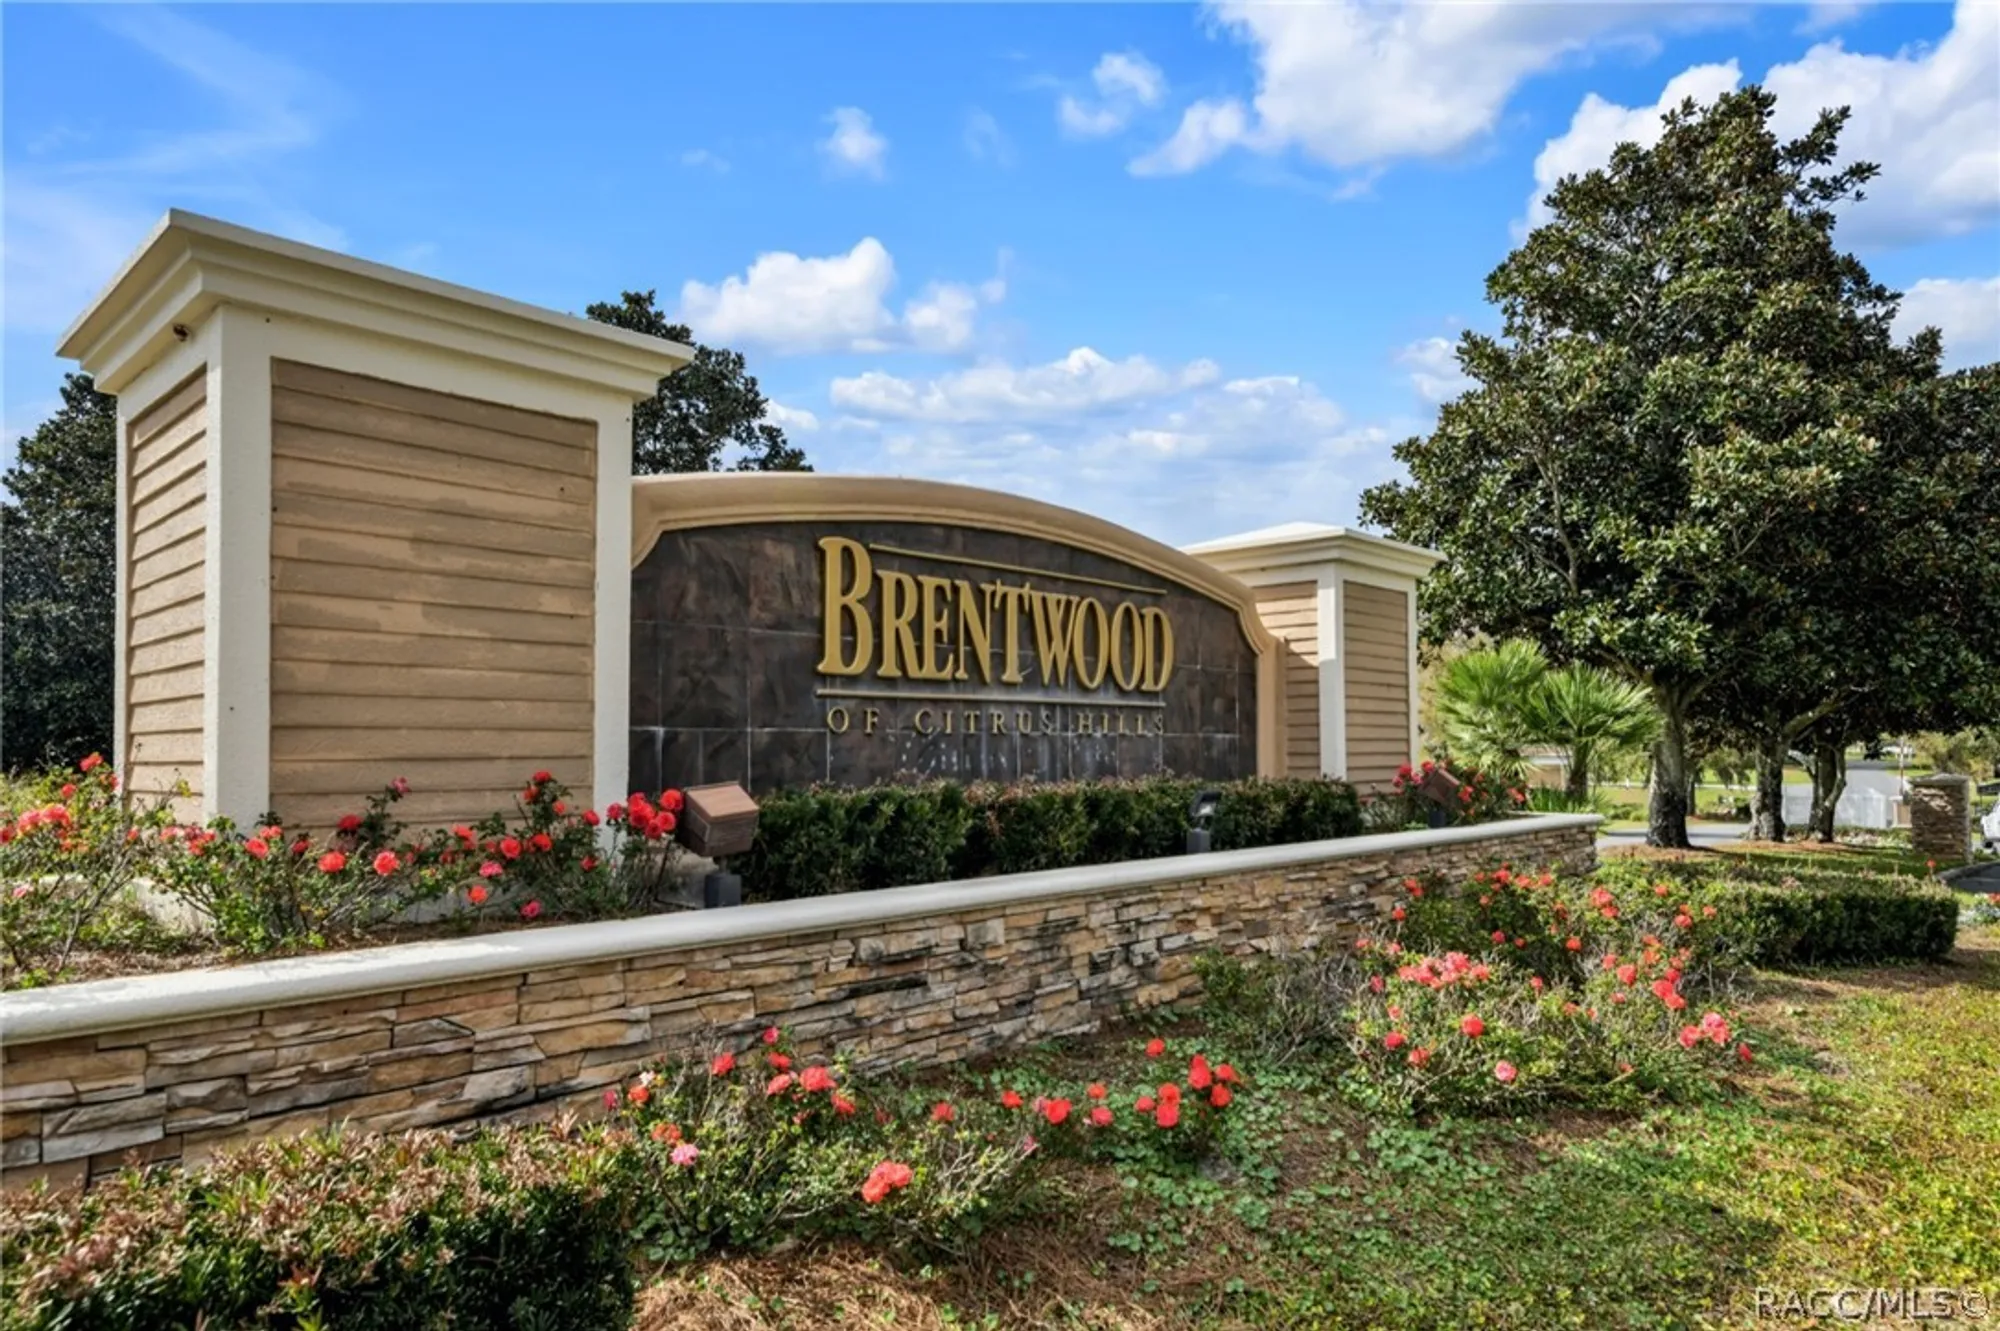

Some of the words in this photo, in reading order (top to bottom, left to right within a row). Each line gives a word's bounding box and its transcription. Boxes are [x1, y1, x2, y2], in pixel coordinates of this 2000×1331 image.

[816, 536, 1174, 692] BRENTWOOD
[826, 708, 880, 735] OF
[914, 708, 1056, 735] CITRUS
[1077, 712, 1164, 736] HILLS
